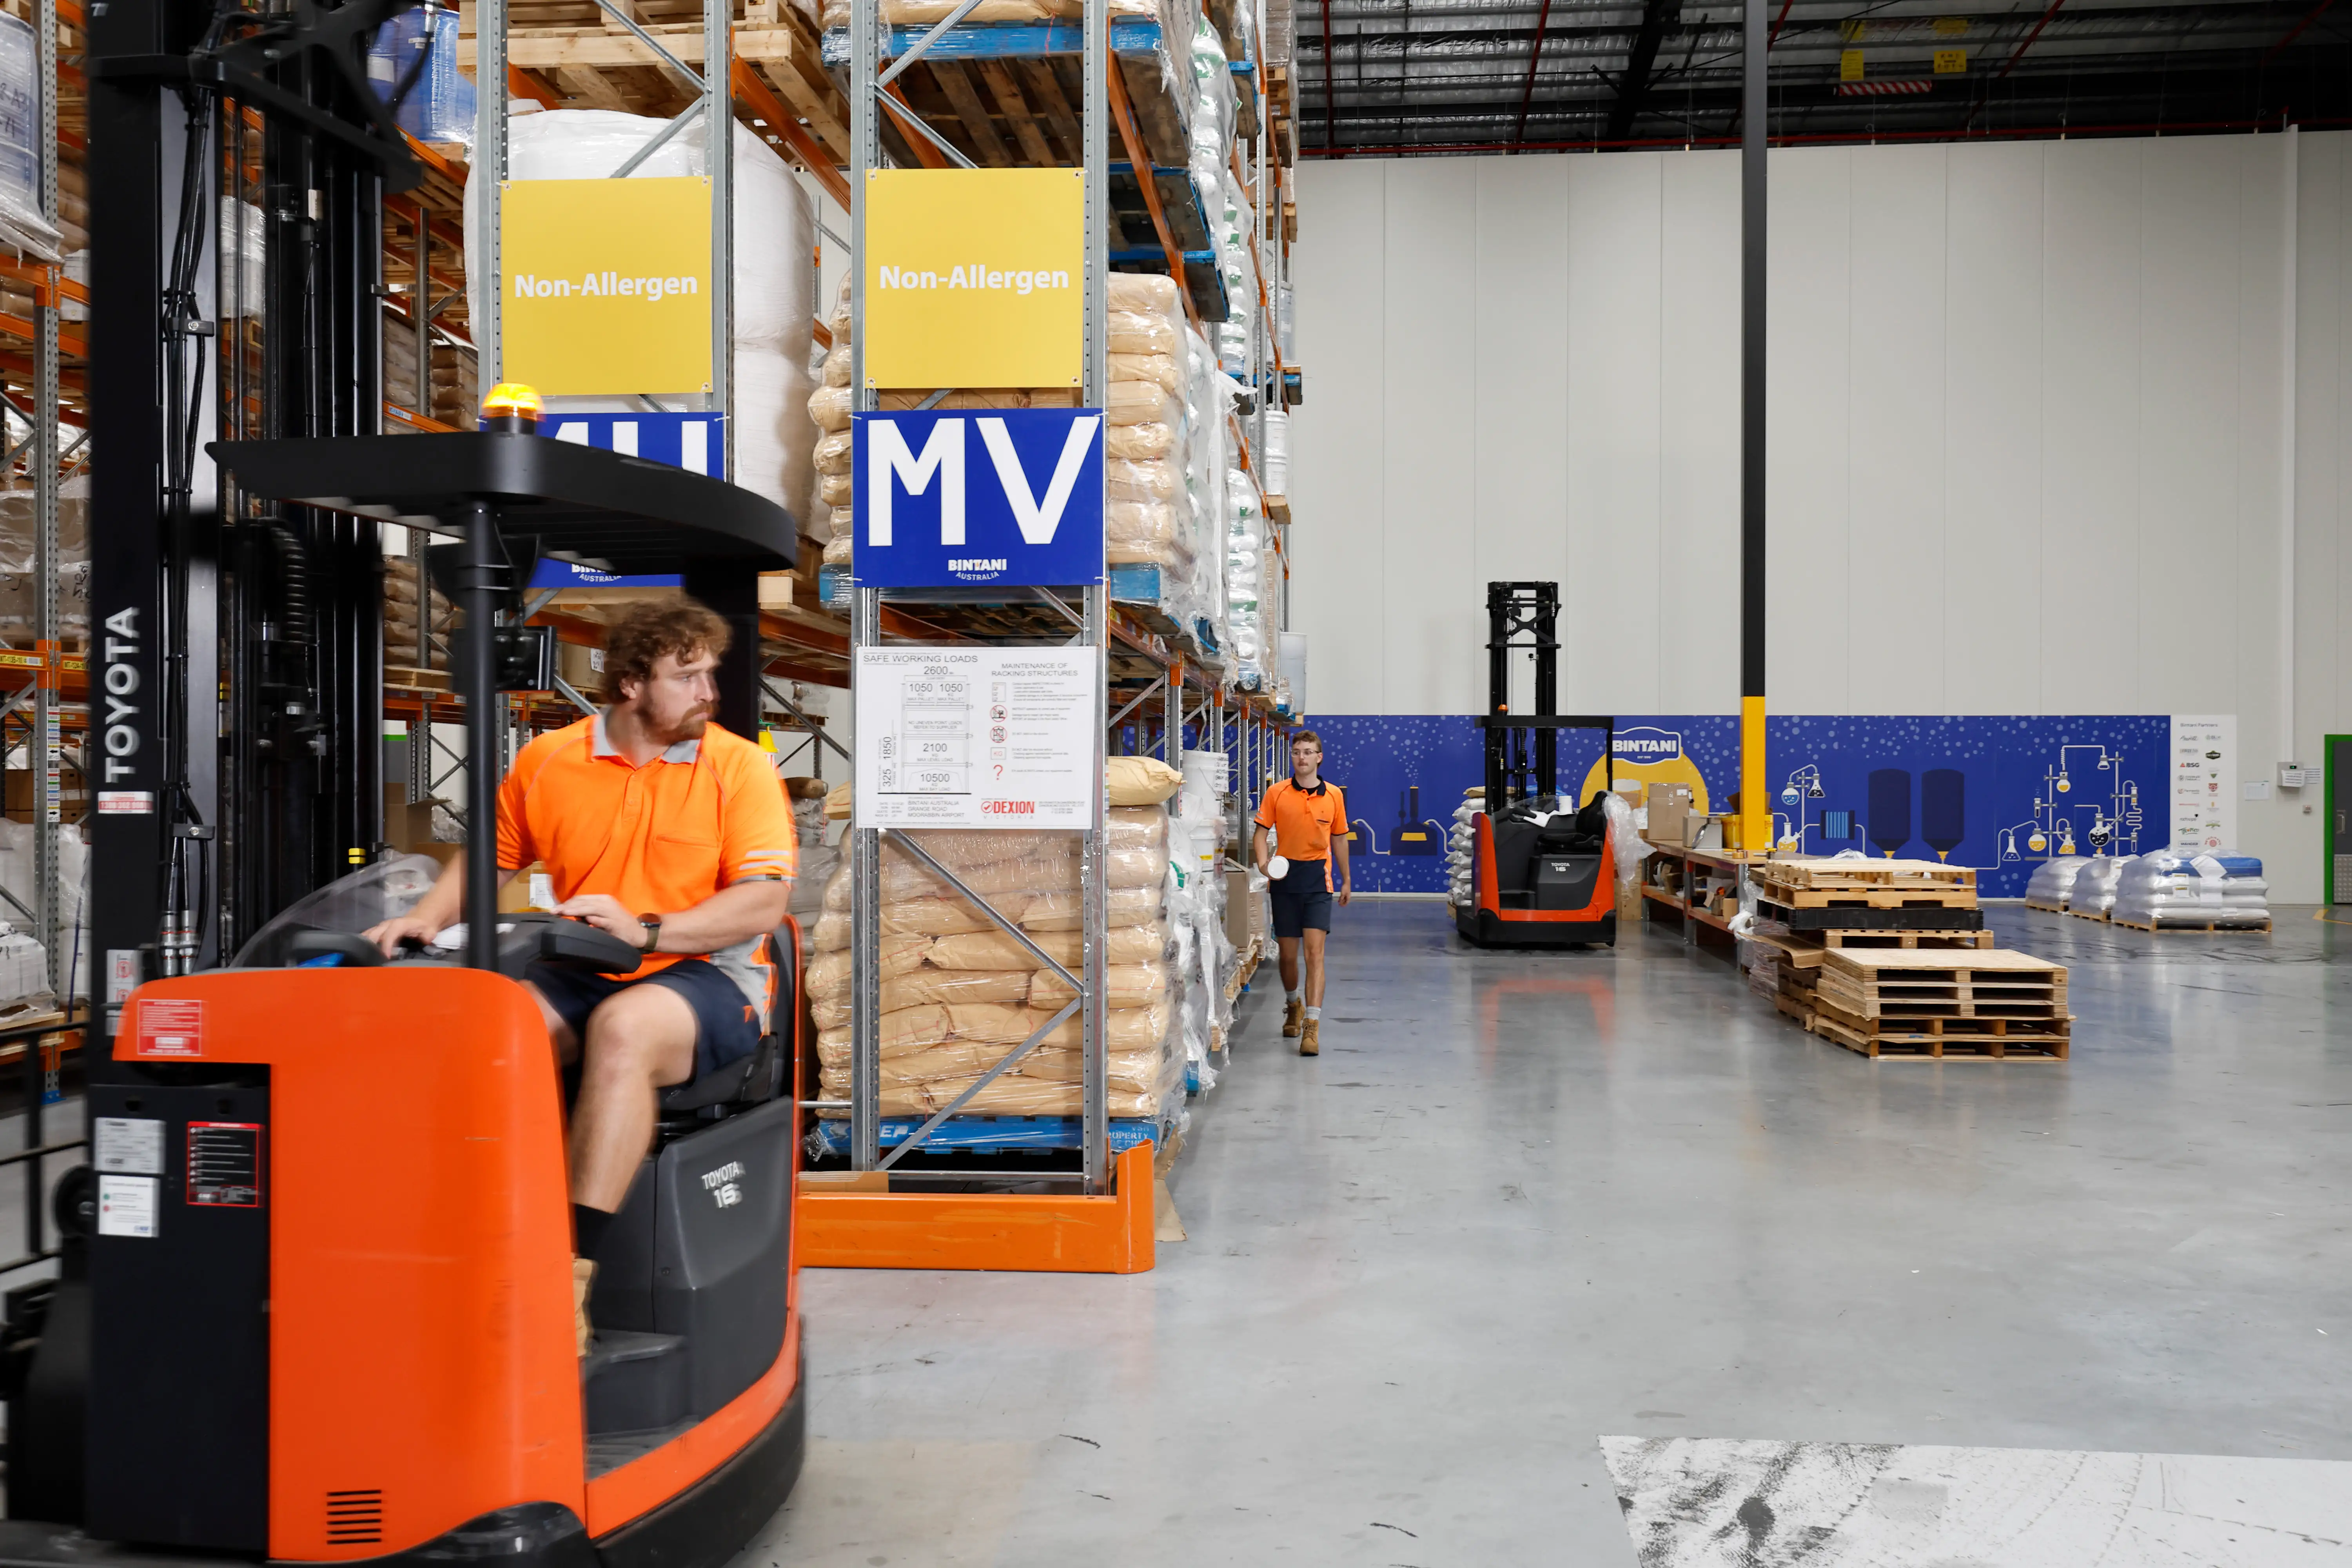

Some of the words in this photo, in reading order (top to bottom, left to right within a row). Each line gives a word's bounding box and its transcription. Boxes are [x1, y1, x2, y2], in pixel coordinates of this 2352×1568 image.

[880, 265, 1069, 295] Non-Allergen
[514, 272, 698, 301] Non-Allergen
[868, 416, 1100, 546] MV
[948, 559, 1007, 571] BINTANI
[955, 571, 999, 581] AUSTRALIA
[924, 666, 948, 675] 2600
[909, 683, 933, 692] 1050
[940, 683, 963, 692] 1050
[105, 606, 139, 783] TOYOTA
[883, 737, 892, 760] 1850
[923, 743, 947, 752] 2100
[1612, 740, 1677, 752] BINTANI
[883, 769, 891, 787] 325
[920, 773, 950, 782] 10500
[994, 801, 1035, 813] DEXION
[880, 1125, 909, 1137] EP
[701, 1161, 741, 1190] TOYOTA
[714, 1183, 737, 1208] 16
